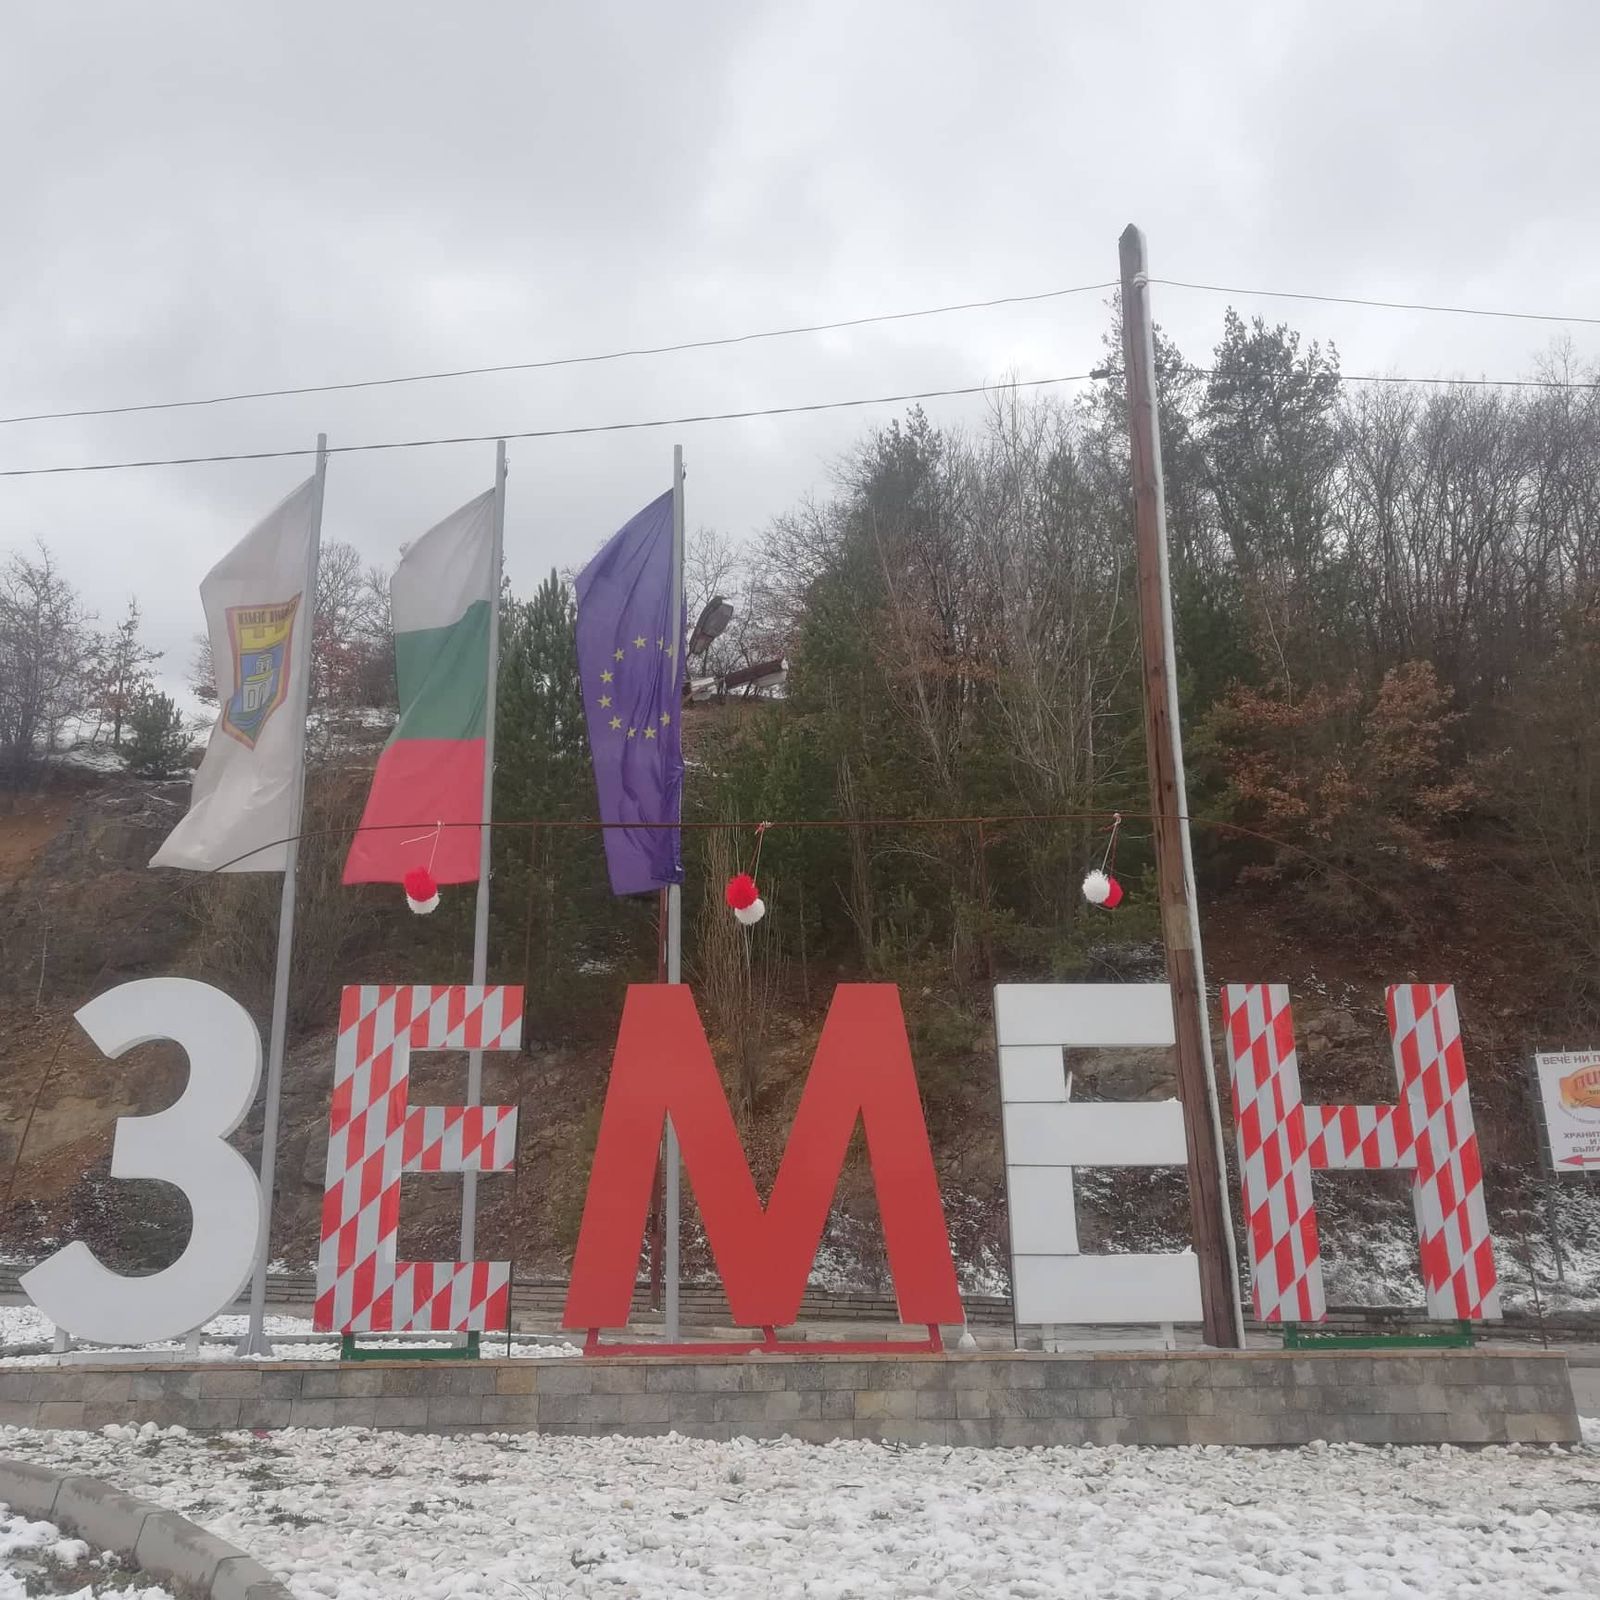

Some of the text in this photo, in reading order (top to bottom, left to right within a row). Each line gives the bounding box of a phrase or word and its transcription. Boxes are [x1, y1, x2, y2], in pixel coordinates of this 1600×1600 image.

[1543, 1056, 1571, 1065] ВЕЧЕ
[1574, 1055, 1590, 1063] НИ
[19, 977, 1503, 1345] ЗЕМЕН
